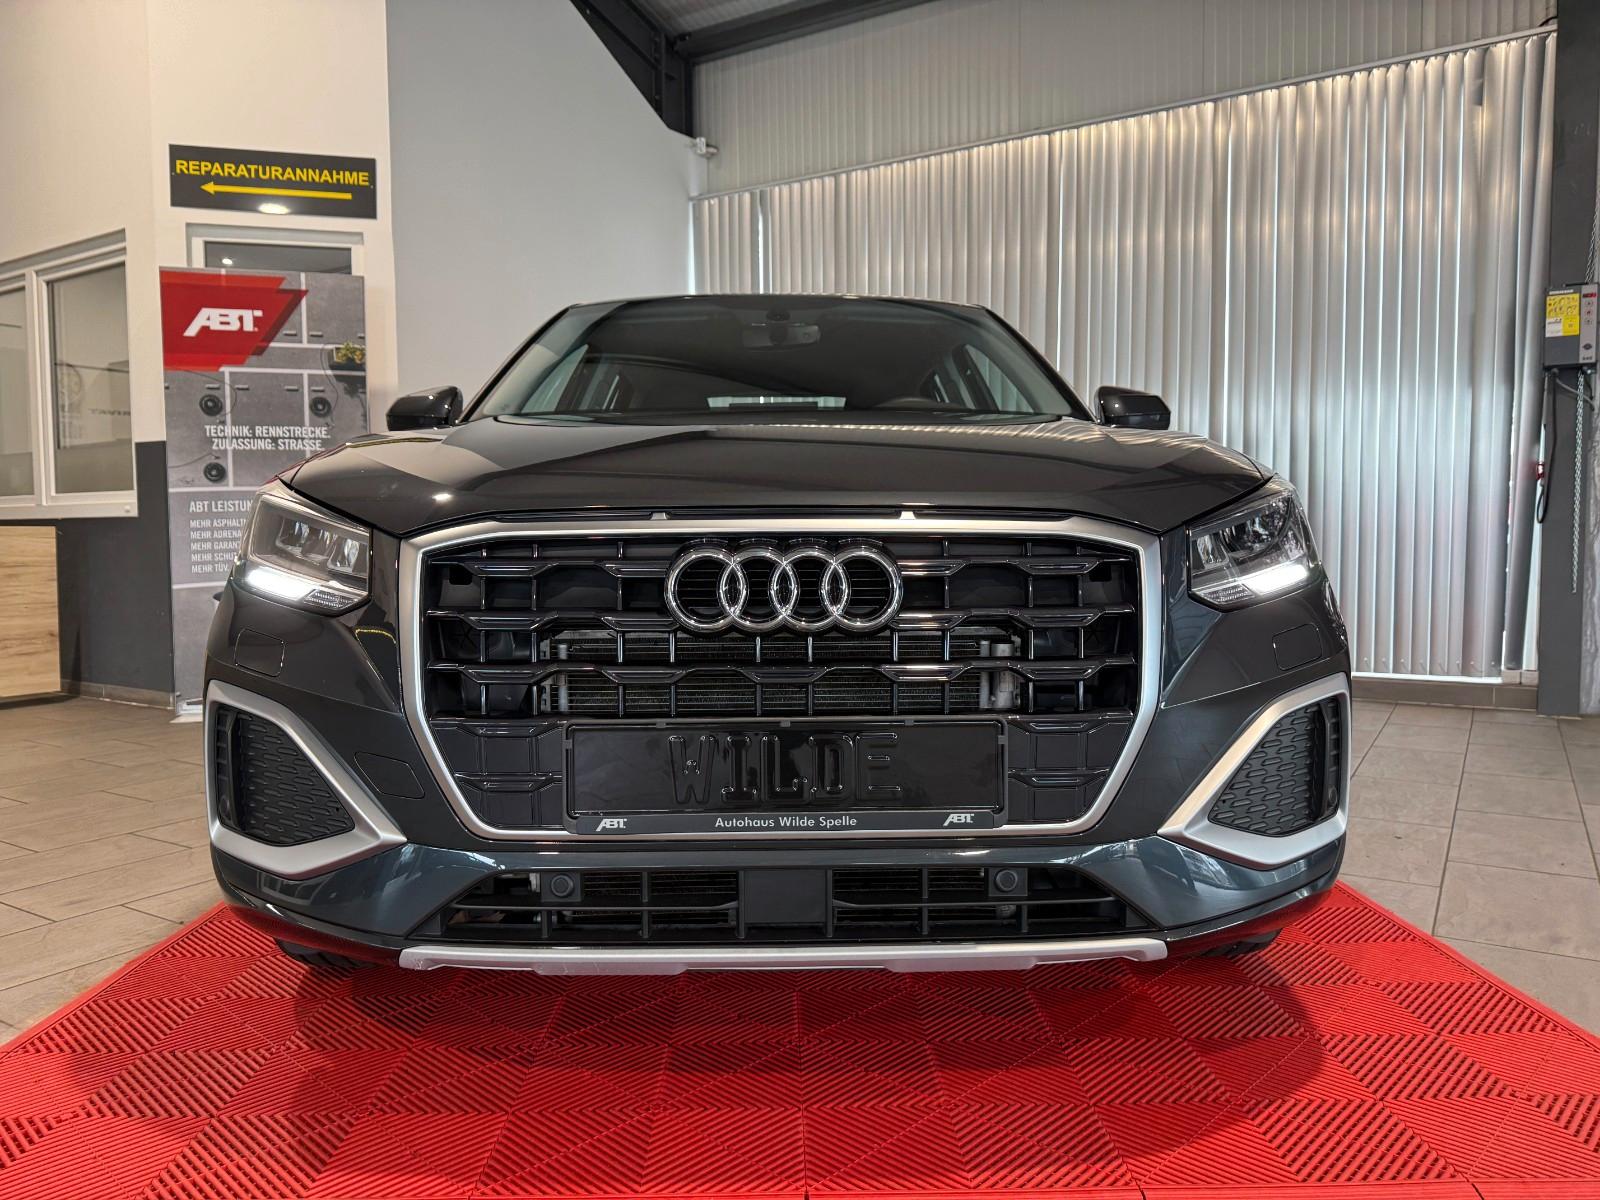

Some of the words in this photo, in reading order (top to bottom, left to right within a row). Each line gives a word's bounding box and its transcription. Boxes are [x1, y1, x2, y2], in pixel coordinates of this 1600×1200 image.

[175, 159, 370, 186] REPARATURANNAHME
[204, 425, 253, 438] TECHNIK:
[255, 425, 331, 439] RENNSTRECKE.
[212, 438, 276, 450] ZULASSUNG:
[277, 439, 326, 451] STRASSE.
[189, 500, 209, 513] ABT
[189, 518, 211, 529] MEHR
[190, 530, 212, 540] MEHR
[190, 541, 212, 551] MEHR
[191, 552, 212, 562] MEHR
[191, 563, 213, 574] MEHR
[668, 733, 901, 805] WILDE
[715, 816, 775, 828] Autohaus
[779, 815, 816, 828] Wilde
[819, 815, 857, 829] Spelle
